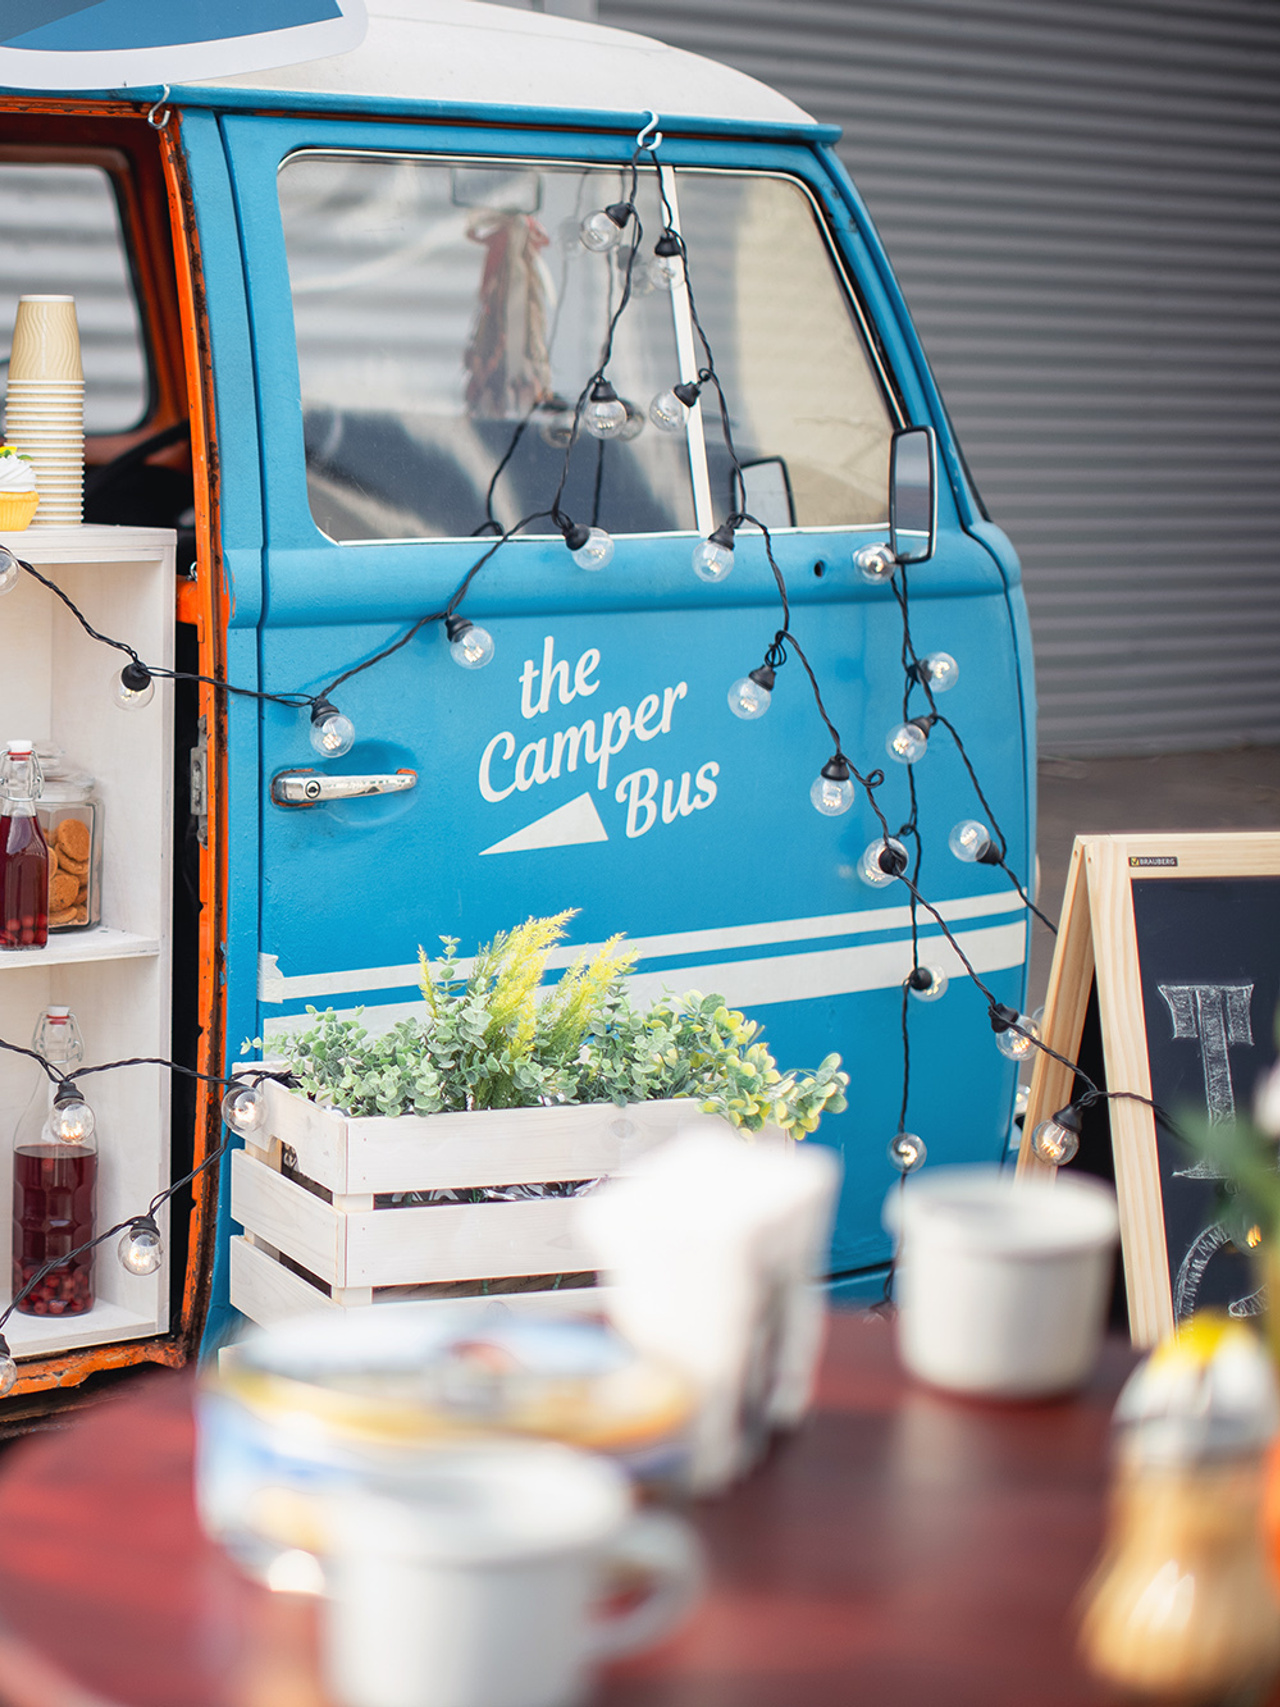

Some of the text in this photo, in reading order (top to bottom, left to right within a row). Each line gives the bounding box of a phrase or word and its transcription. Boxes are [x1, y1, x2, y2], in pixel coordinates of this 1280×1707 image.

[518, 635, 601, 720] the
[478, 681, 688, 803] Camper
[614, 760, 721, 839] Bus
